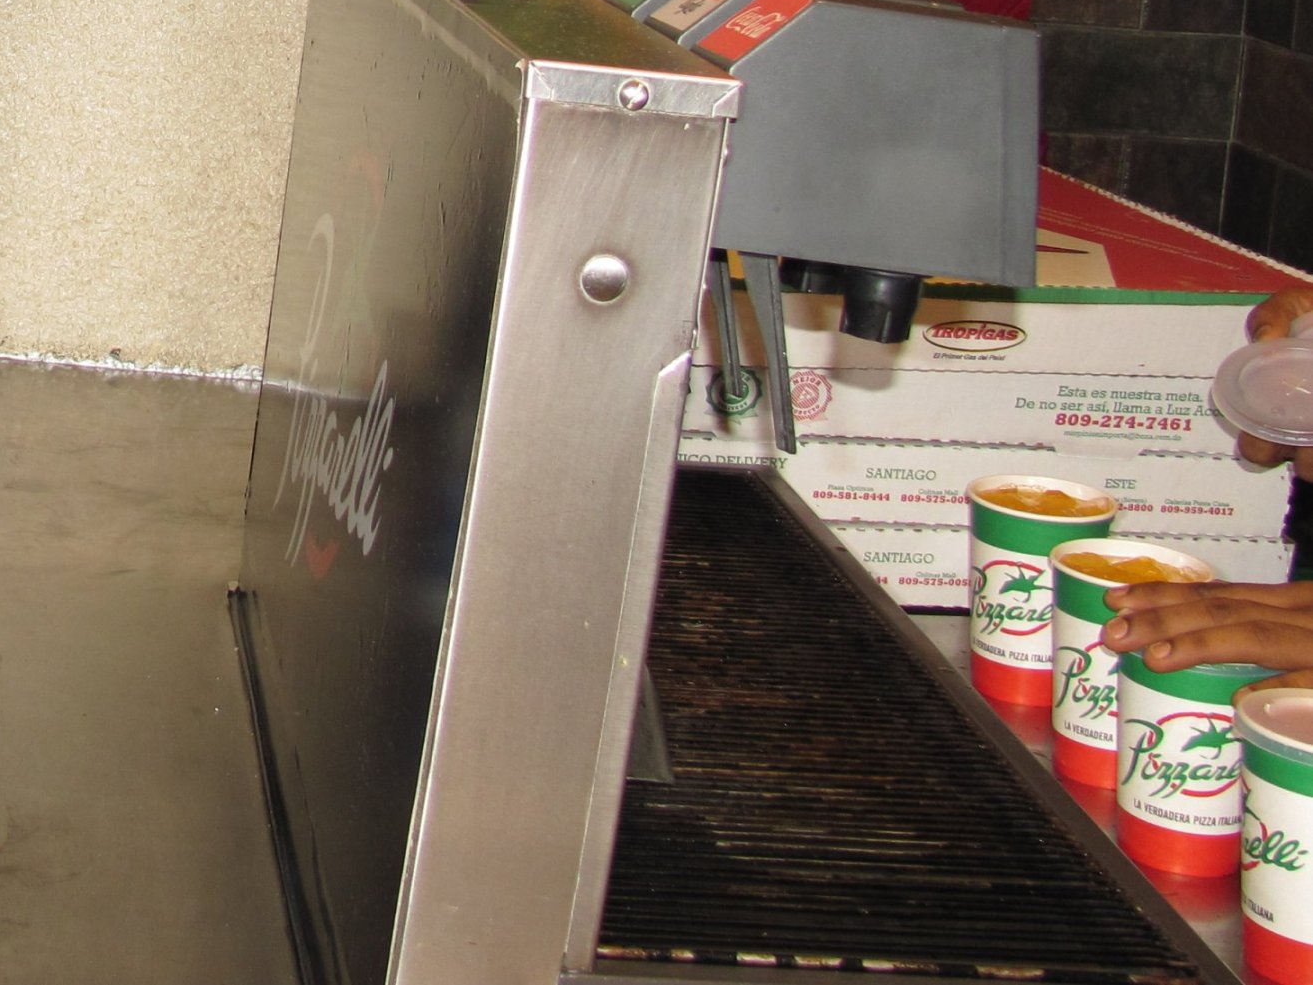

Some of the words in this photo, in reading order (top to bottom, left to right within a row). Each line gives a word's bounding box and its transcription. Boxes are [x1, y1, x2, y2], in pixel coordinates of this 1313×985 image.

[1057, 386, 1087, 398] Esta
[1091, 389, 1107, 399] es
[1111, 390, 1162, 401] nuestra
[1165, 392, 1203, 402] meta.
[1015, 398, 1035, 409] De
[1039, 401, 1057, 410] no
[1060, 402, 1083, 412] ser
[1112, 402, 1151, 414] llama
[1155, 406, 1163, 414] a
[1167, 404, 1190, 415] Luz
[1055, 413, 1192, 431] 809-274-7461
[865, 468, 937, 481] SANTIAGO
[1105, 478, 1137, 490] ESTE
[813, 491, 890, 502] 809-581-8444
[1161, 505, 1234, 516] 809-959-4017
[864, 552, 935, 564] SANTIAGO
[1009, 651, 1029, 661] PIZZA
[1064, 720, 1071, 731] LA
[1072, 723, 1114, 742] VERDADERA
[1134, 798, 1142, 809] LA
[1144, 804, 1190, 823] VERDADERA
[1193, 816, 1216, 827] PIZZA
